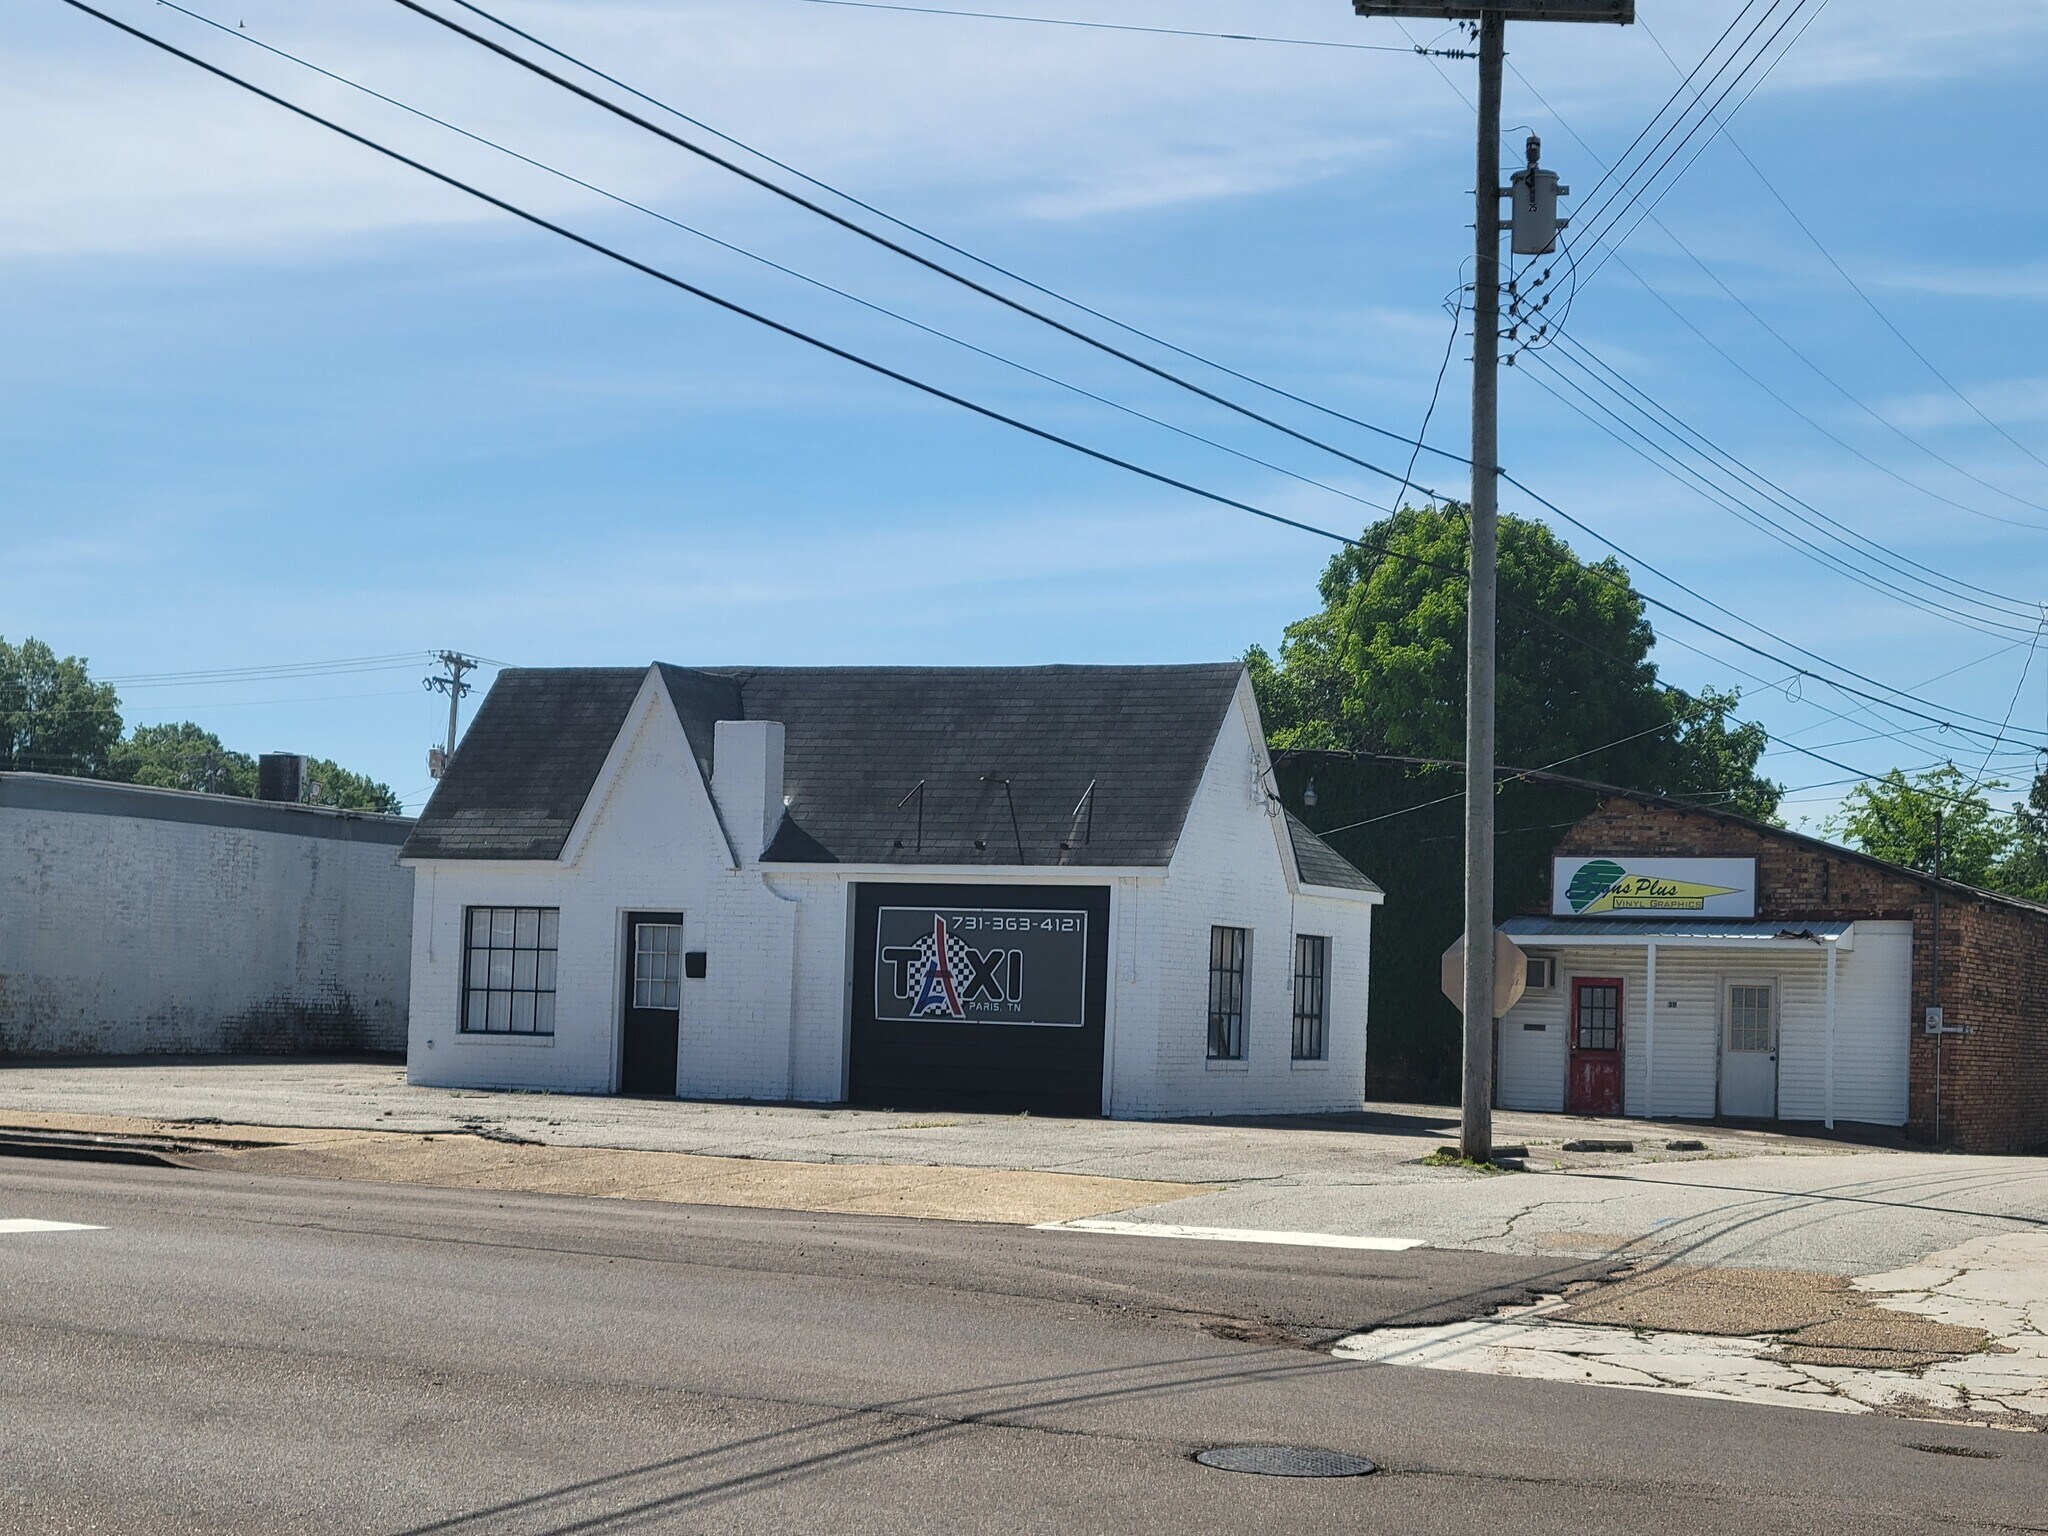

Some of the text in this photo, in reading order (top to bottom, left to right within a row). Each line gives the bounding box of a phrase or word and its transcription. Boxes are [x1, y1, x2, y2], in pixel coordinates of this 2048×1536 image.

[1634, 878, 1679, 897] Plus
[1615, 899, 1703, 909] VINYL GRAPHICS
[951, 916, 1081, 933] 731-363-4121
[882, 913, 1024, 1019] TAXI
[1007, 1003, 1021, 1013] TN
